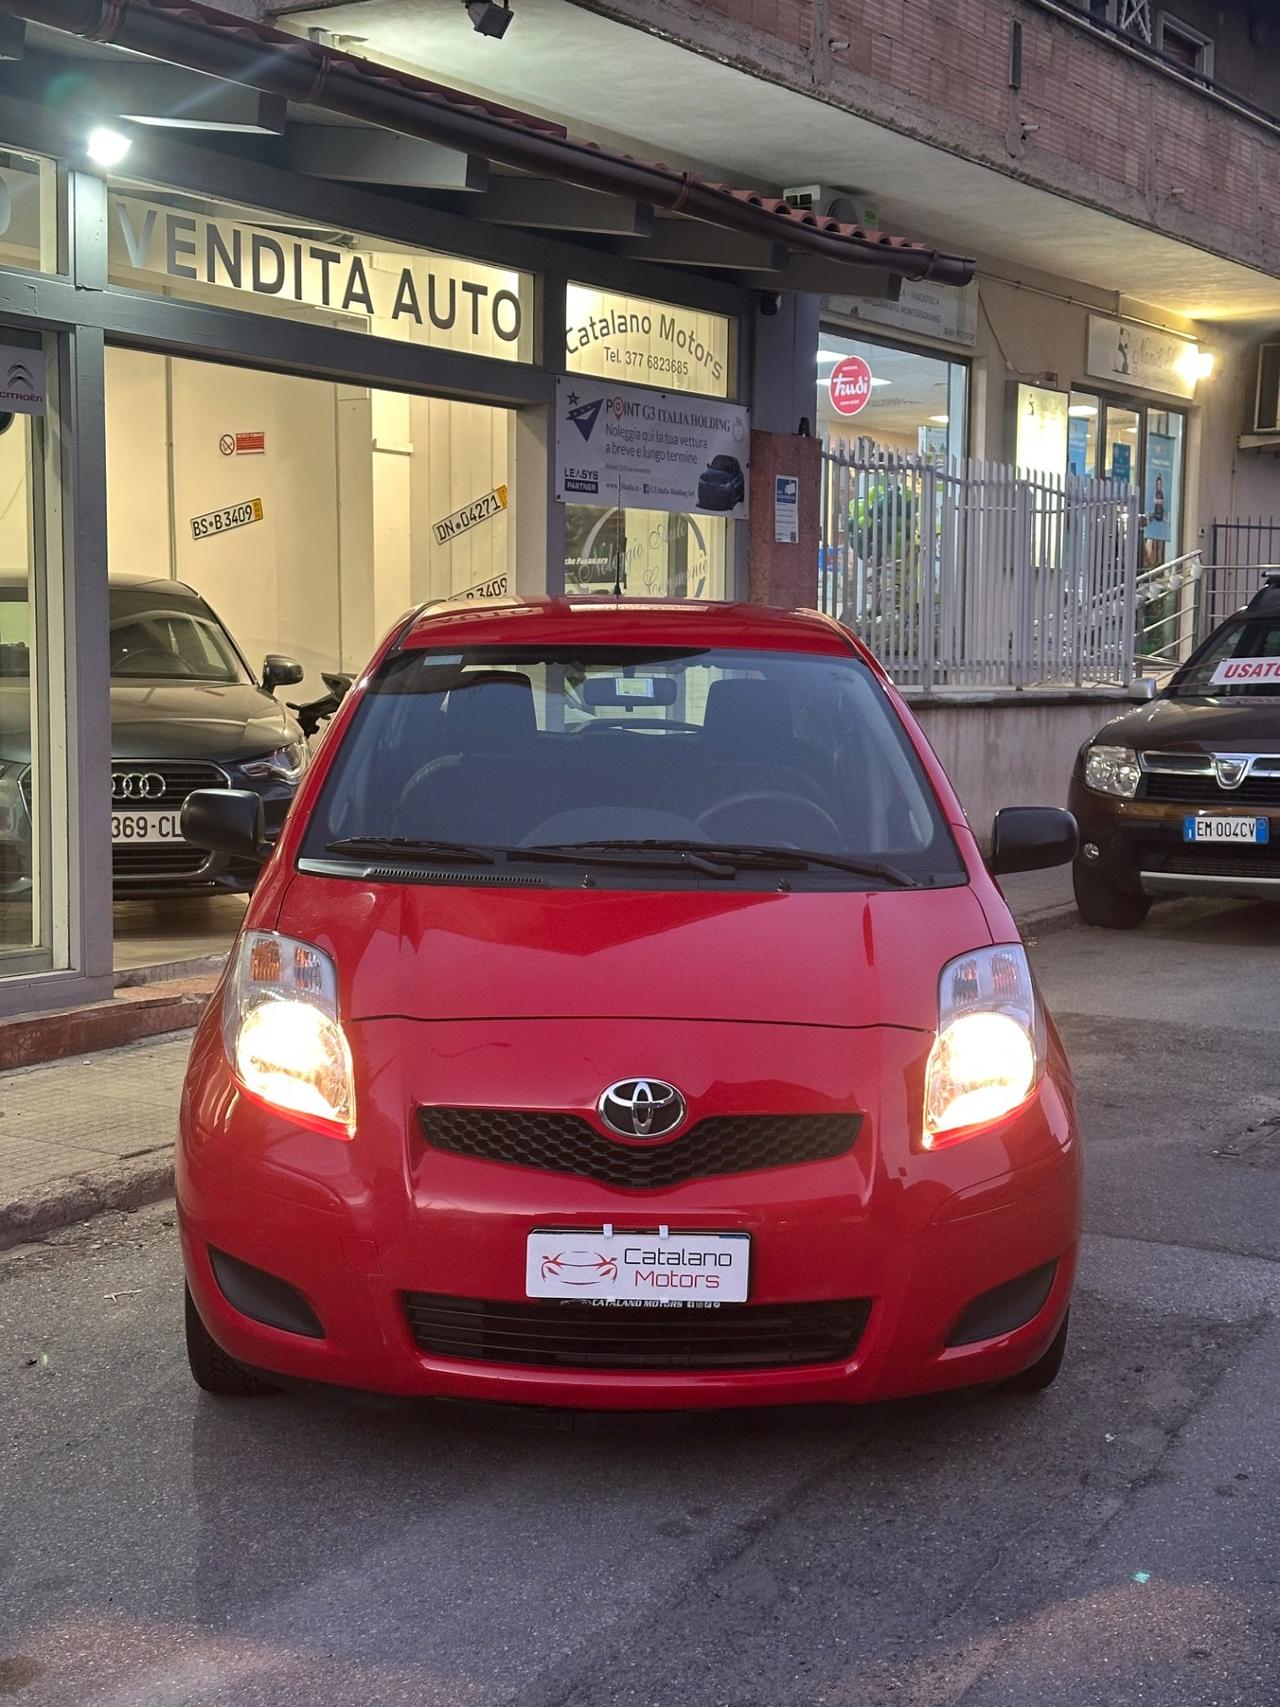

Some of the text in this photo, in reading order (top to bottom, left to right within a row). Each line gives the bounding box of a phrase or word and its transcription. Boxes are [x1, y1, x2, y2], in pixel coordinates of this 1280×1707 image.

[115, 202, 374, 314] VENDITA
[392, 268, 521, 341] AUTO
[566, 309, 723, 380] Catalano Motors
[604, 347, 688, 375] Tel. 377 6823685
[642, 405, 656, 420] G3
[658, 409, 689, 426] ITALIA
[691, 416, 731, 432] HOLDING
[606, 423, 641, 442] Noleggia
[642, 429, 655, 442] qui
[680, 435, 708, 449] vettura
[612, 442, 635, 457] breve
[643, 448, 665, 463] lungo
[667, 450, 698, 464] termine
[567, 481, 598, 492] PARTNER
[624, 1247, 732, 1267] Catalano
[635, 1270, 720, 1289] Motors
